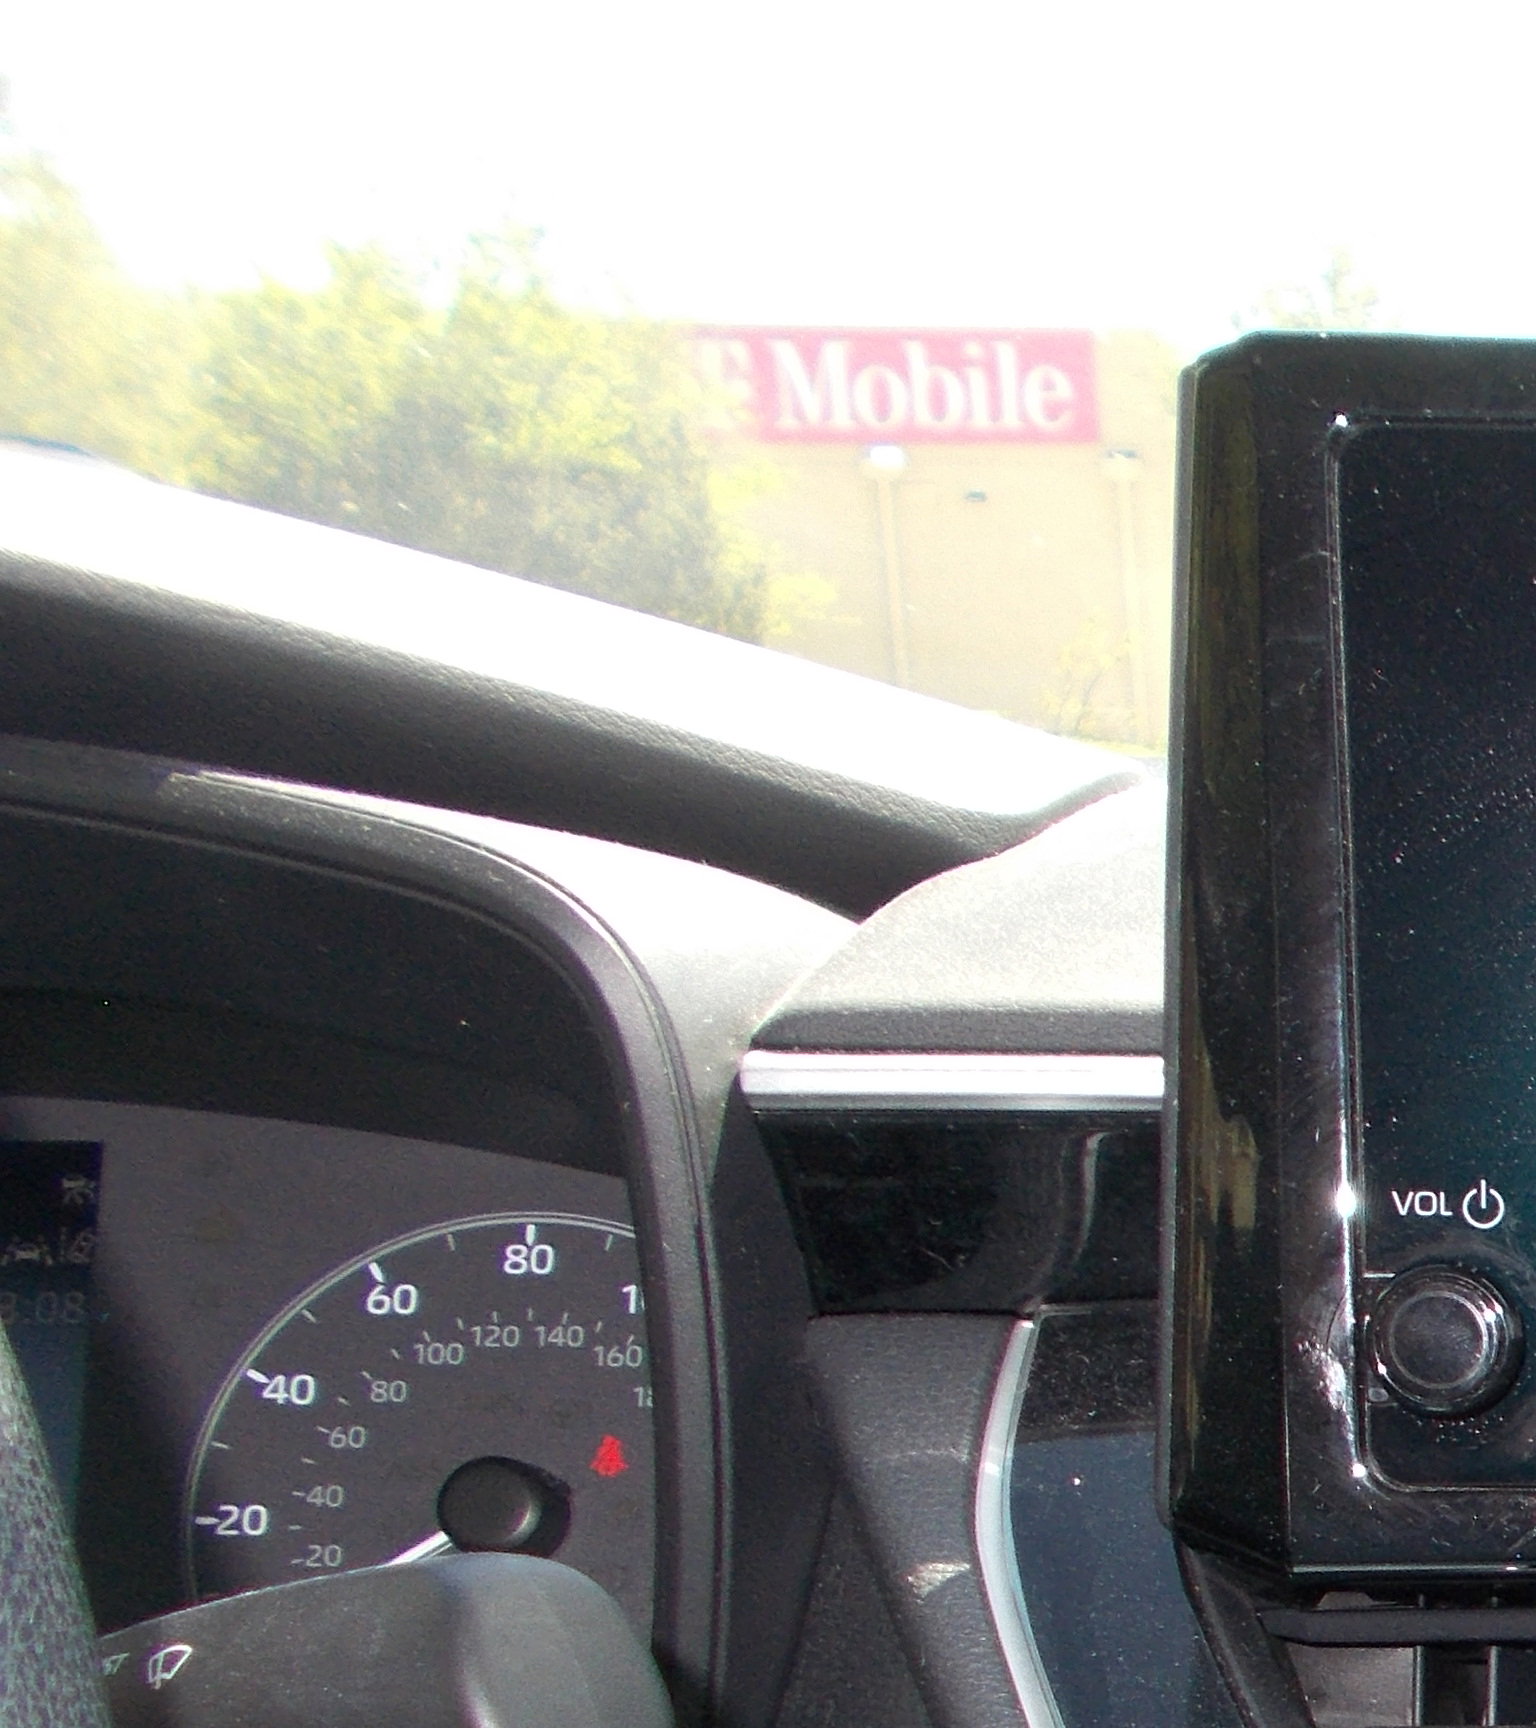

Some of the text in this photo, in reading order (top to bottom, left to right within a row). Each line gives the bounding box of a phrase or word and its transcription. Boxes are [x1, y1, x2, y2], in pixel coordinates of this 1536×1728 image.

[1391, 1189, 1452, 1217] VOL
[503, 1244, 555, 1275] 80
[365, 1284, 418, 1315] 60
[471, 1325, 521, 1348] 120
[535, 1325, 585, 1348] 140
[413, 1342, 465, 1366] 100
[593, 1345, 643, 1369] 160
[262, 1374, 316, 1405] 40
[370, 1380, 407, 1403] 80
[329, 1425, 367, 1449] 60
[305, 1484, 344, 1508] 40
[215, 1504, 268, 1536] 20
[305, 1544, 342, 1568] 20
